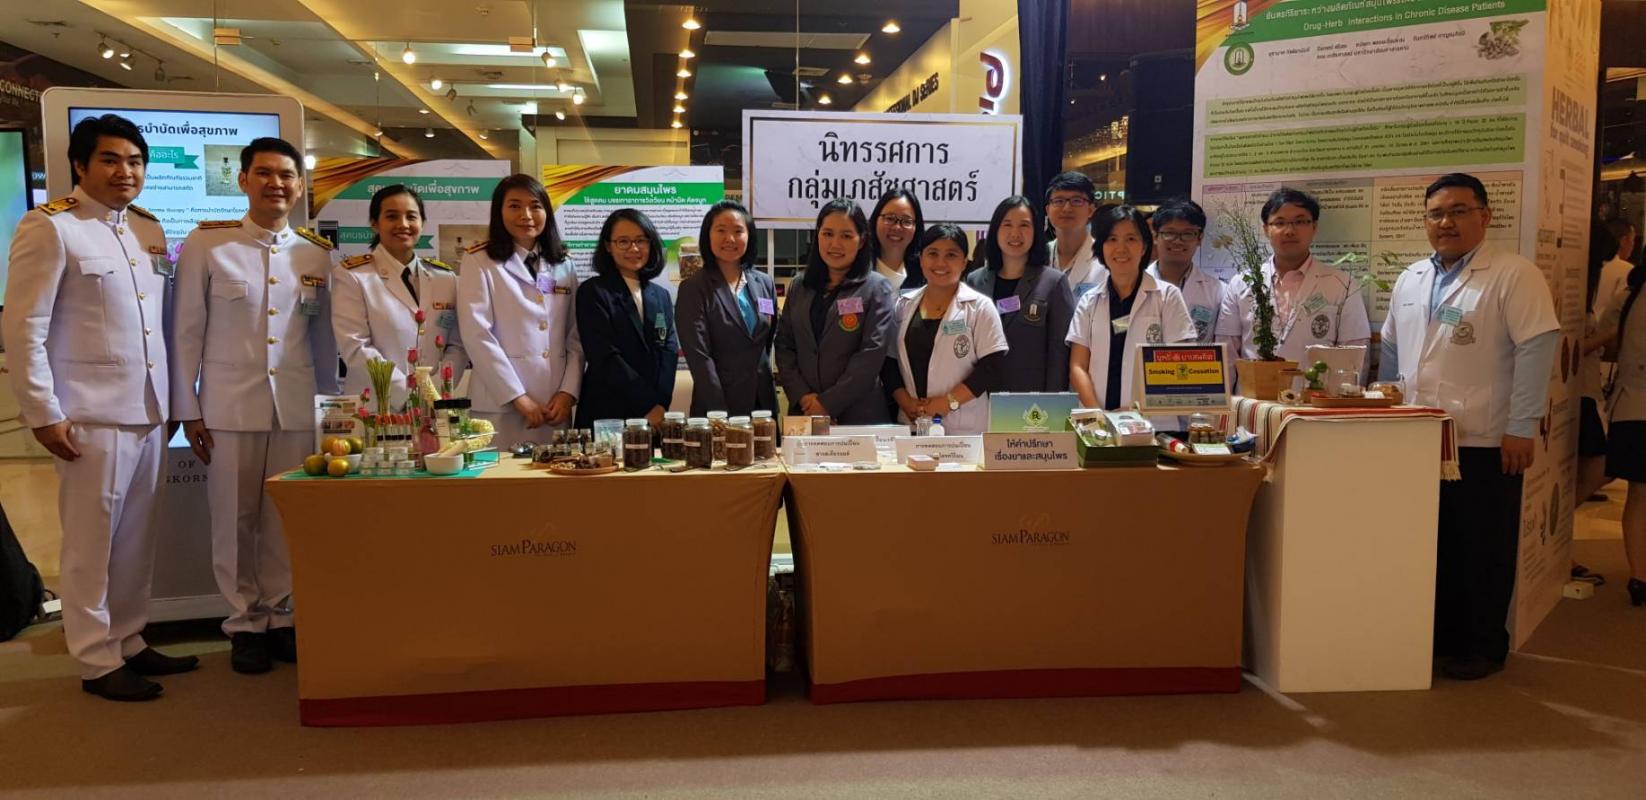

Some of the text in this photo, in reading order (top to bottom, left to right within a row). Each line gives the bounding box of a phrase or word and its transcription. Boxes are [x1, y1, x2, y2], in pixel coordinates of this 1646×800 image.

[1304, 1, 1506, 31] Drug-Herb Interactions in Chronic Disease Patients
[1551, 86, 1590, 140] HERBAL
[818, 131, 949, 164] นิทรรศการ
[1148, 368, 1175, 376] Smoking
[1006, 438, 1054, 449] ให้คำปรึกษา
[994, 448, 1069, 462] เรื่องยาและสมุนไพร
[177, 459, 196, 470] OF
[991, 529, 1070, 545] SIAM PARAGON
[490, 539, 577, 557] SIAM PARAGON
